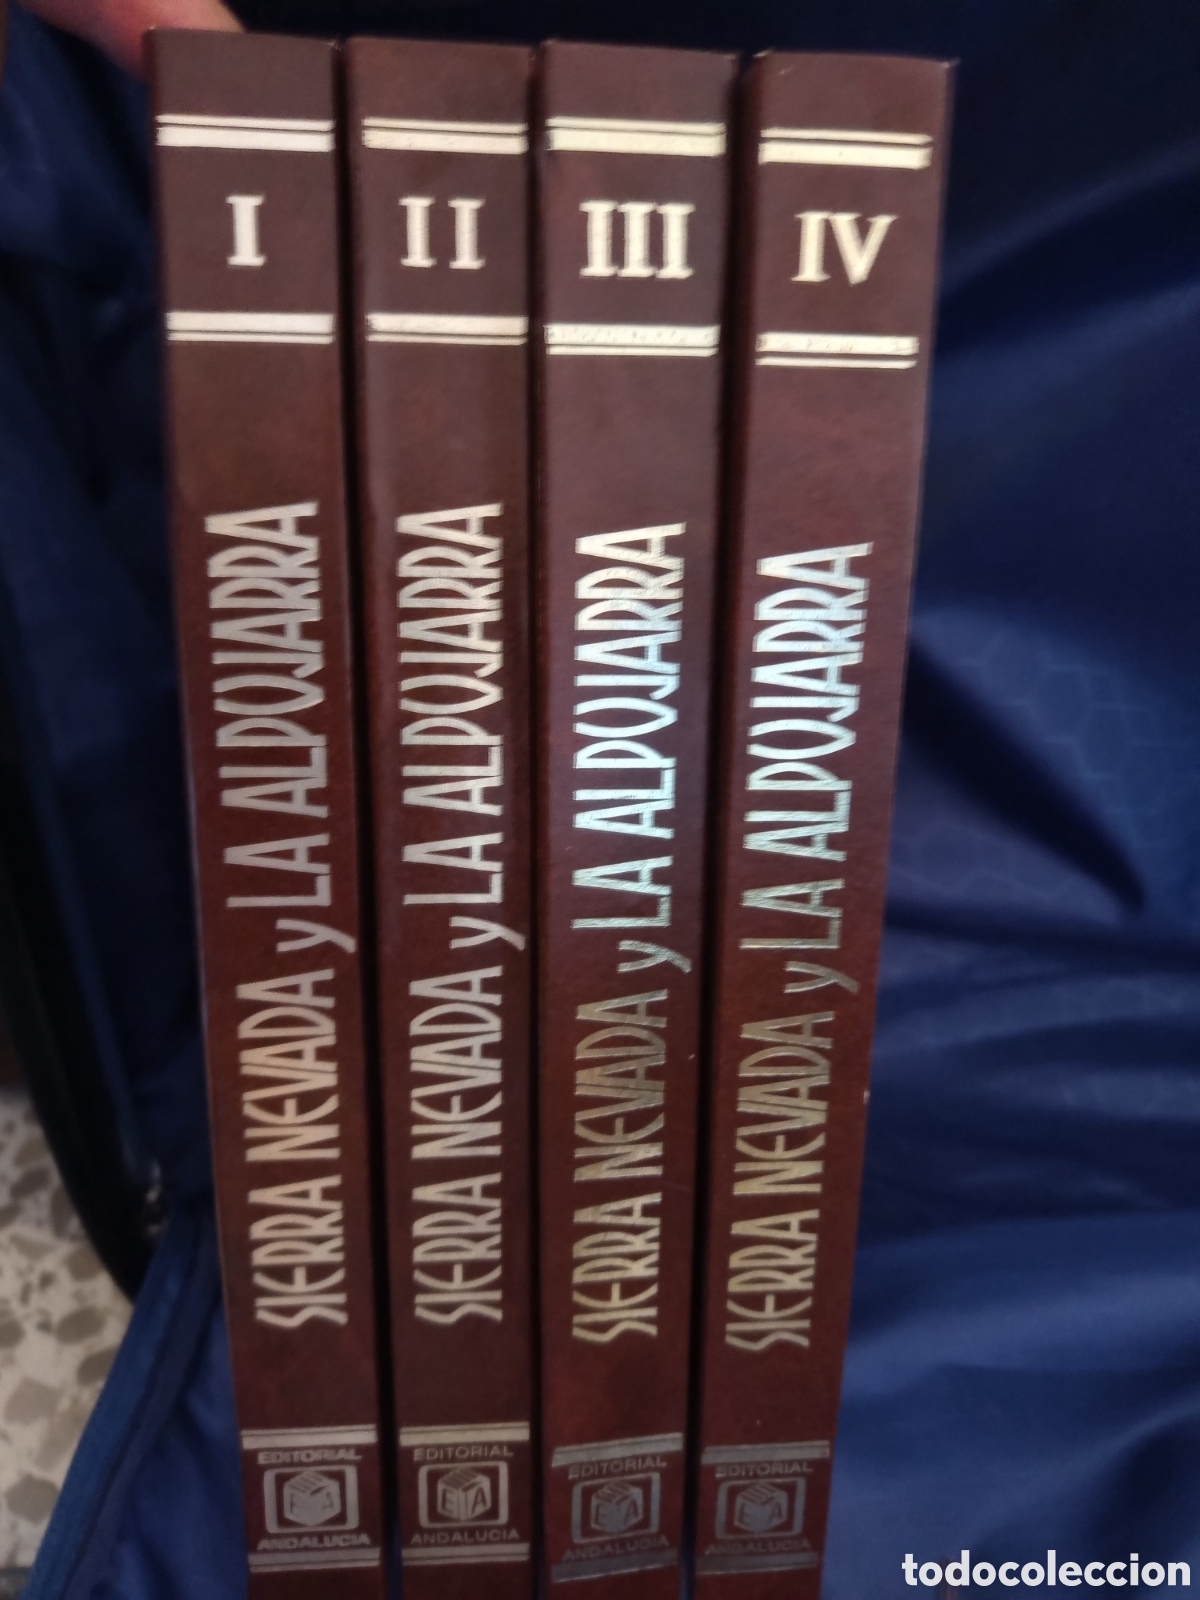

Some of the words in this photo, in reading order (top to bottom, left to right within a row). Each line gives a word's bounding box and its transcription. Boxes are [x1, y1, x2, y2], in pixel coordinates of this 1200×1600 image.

[227, 194, 265, 268] I
[401, 196, 485, 270] II
[580, 201, 694, 279] III
[793, 211, 897, 285] IV
[205, 501, 328, 818] ALPUJARRA
[396, 503, 504, 816] ALPUJARRA
[572, 522, 686, 839] ALPUJARRA
[743, 542, 873, 862] ALPUJARRA
[224, 833, 332, 908] LA
[403, 832, 504, 905] LA
[571, 855, 673, 929] LA
[276, 917, 356, 954] y
[449, 916, 526, 951] y
[740, 878, 845, 950] LA
[617, 940, 692, 974] y
[783, 961, 860, 994] y
[236, 968, 340, 1162] NEVADA
[409, 965, 503, 1160] NEVADA
[574, 988, 668, 1183] NEVADA
[733, 1011, 835, 1196] NEVADA
[247, 1175, 348, 1328] SIERRA
[412, 1172, 503, 1325] SIERRA
[572, 1192, 662, 1342] SIERRA
[725, 1209, 820, 1351] SIERRA
[257, 1448, 362, 1465] EDITORIAL
[413, 1445, 514, 1462] EDITORIAL
[568, 1455, 667, 1480] EDITORIAL
[715, 1460, 813, 1478] EDITORIAL
[257, 1532, 372, 1550] ANDALUCIA
[410, 1528, 520, 1546] ANDALUCIA
[562, 1535, 669, 1560] ANDALUCIA
